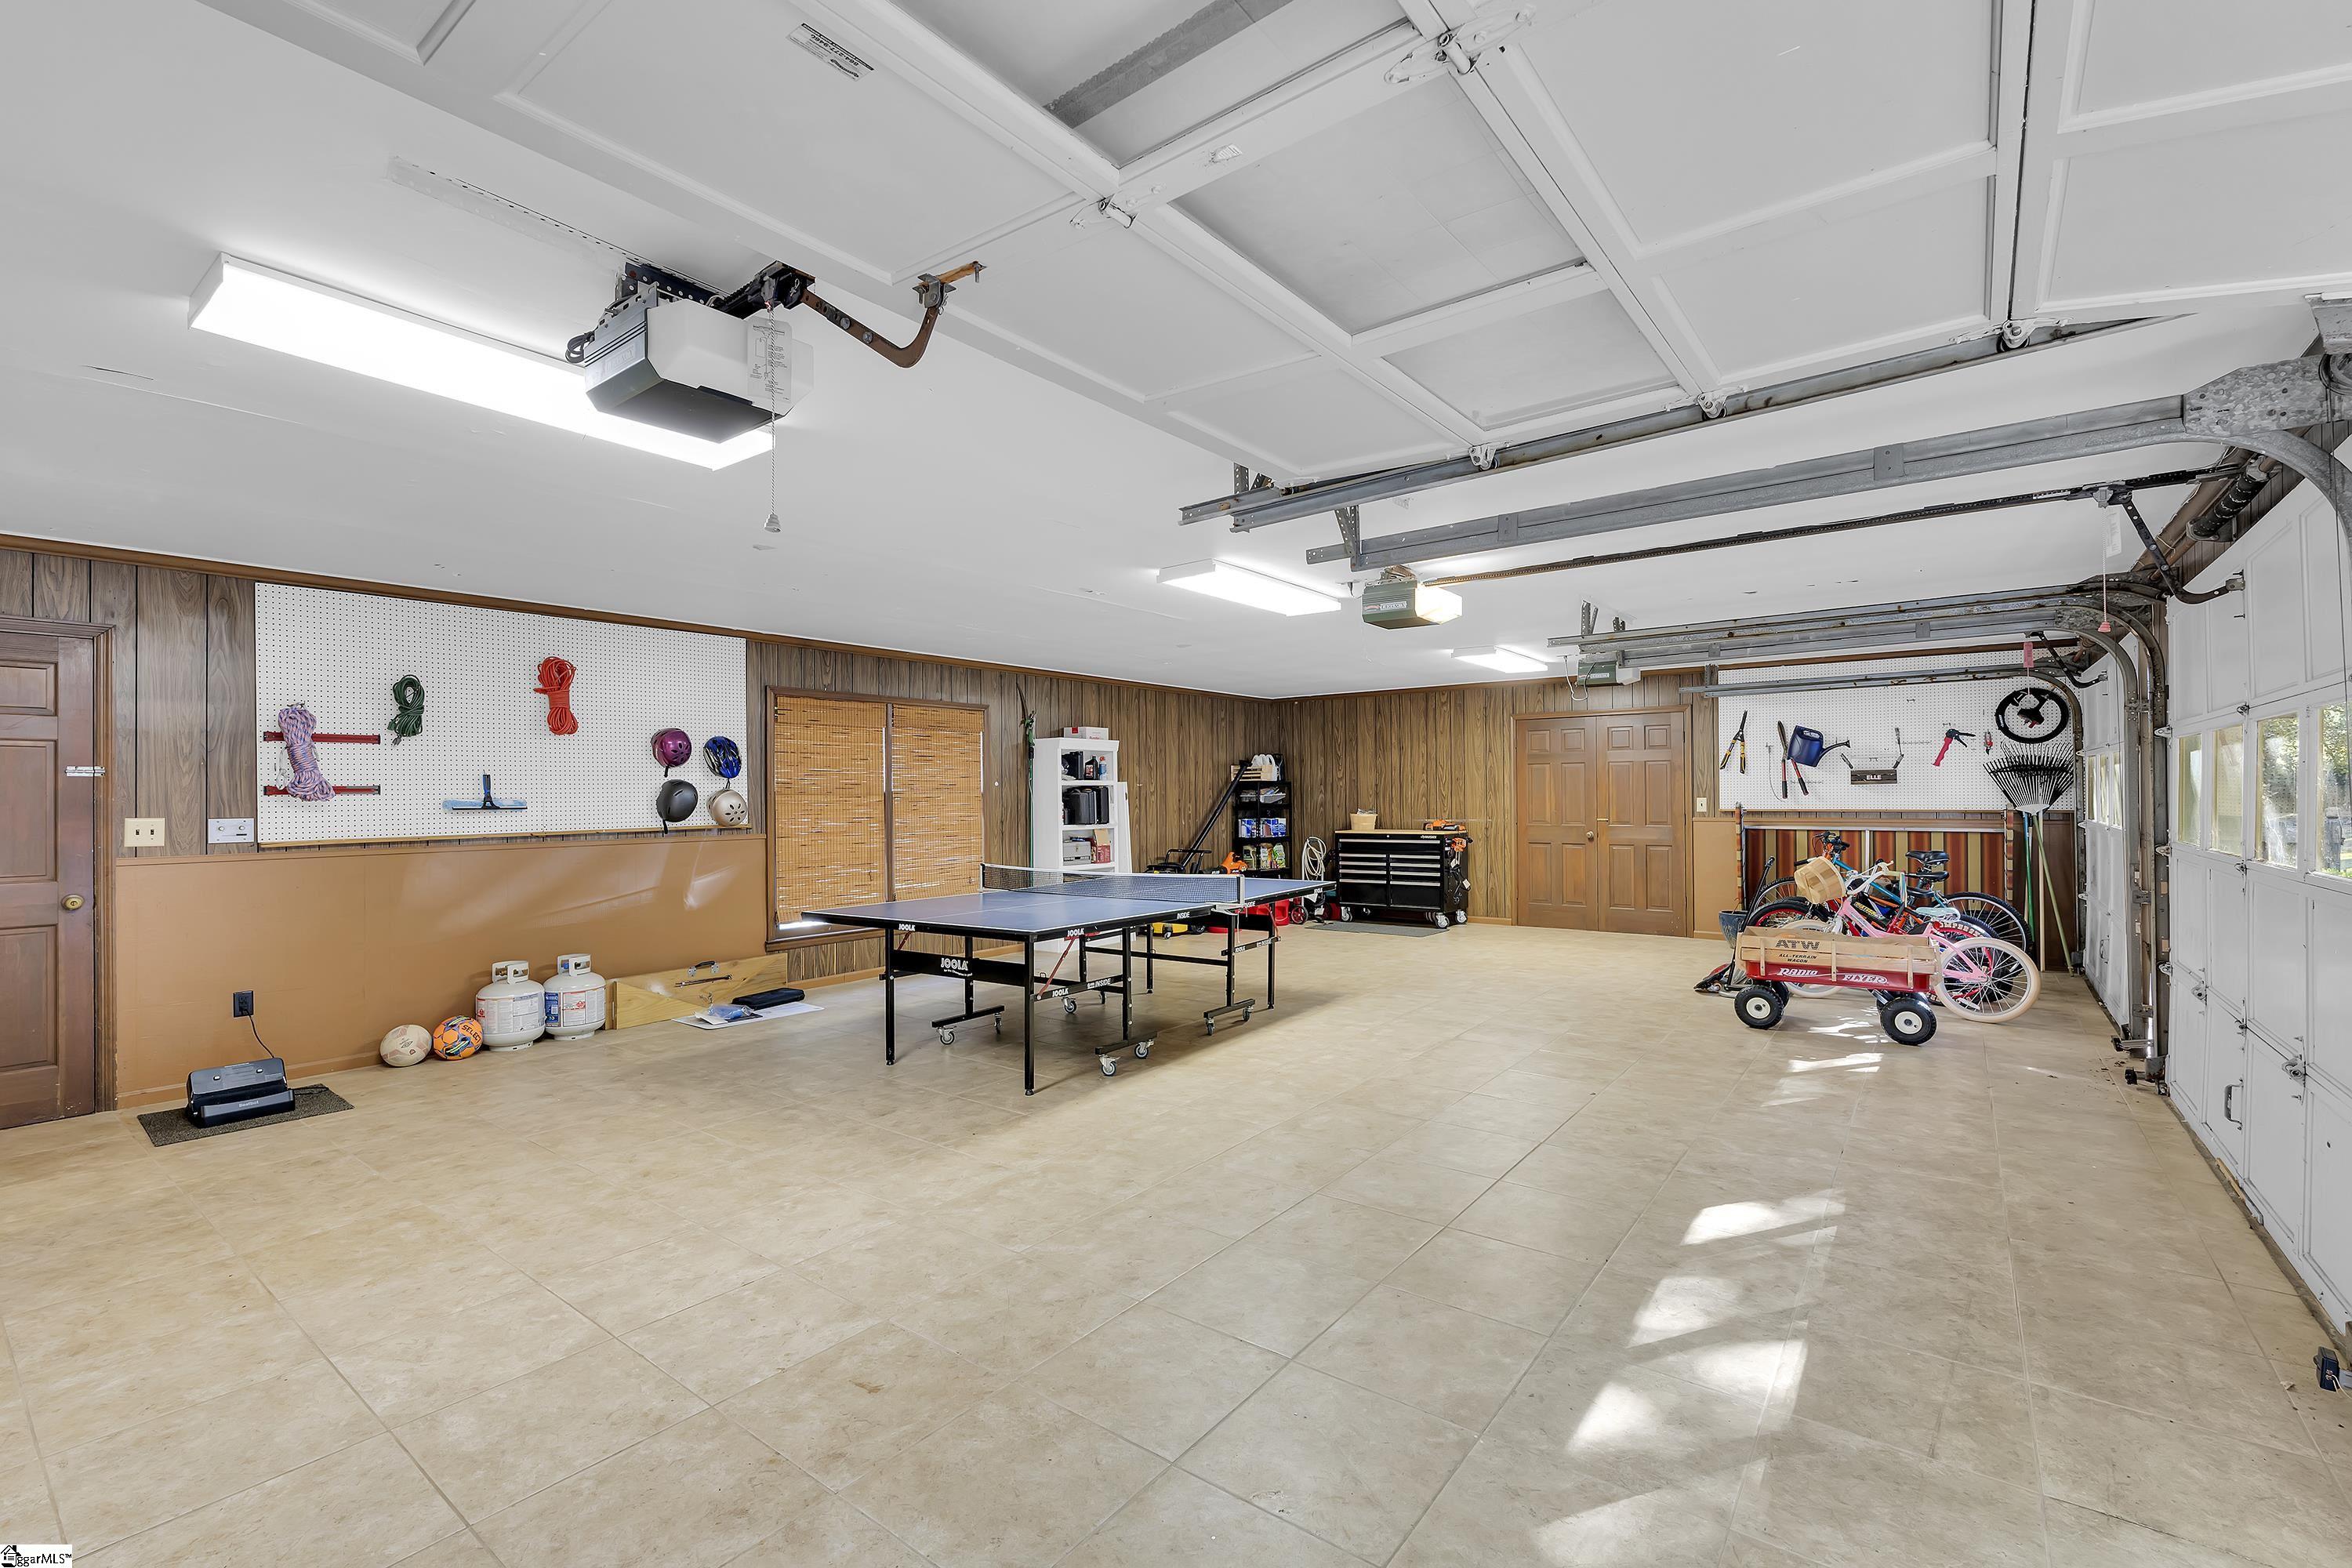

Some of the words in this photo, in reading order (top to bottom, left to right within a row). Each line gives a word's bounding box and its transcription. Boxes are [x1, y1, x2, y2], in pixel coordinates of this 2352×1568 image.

[1067, 927, 1084, 937] JOOLA
[1775, 939, 1820, 950] ATW
[941, 957, 969, 971] JOOLA
[1777, 967, 1819, 977] RADIO
[1842, 974, 1888, 984] FLYER
[1094, 978, 1112, 989] INSIDE
[1052, 988, 1069, 998] JOOLA
[462, 1024, 481, 1044] SELECT
